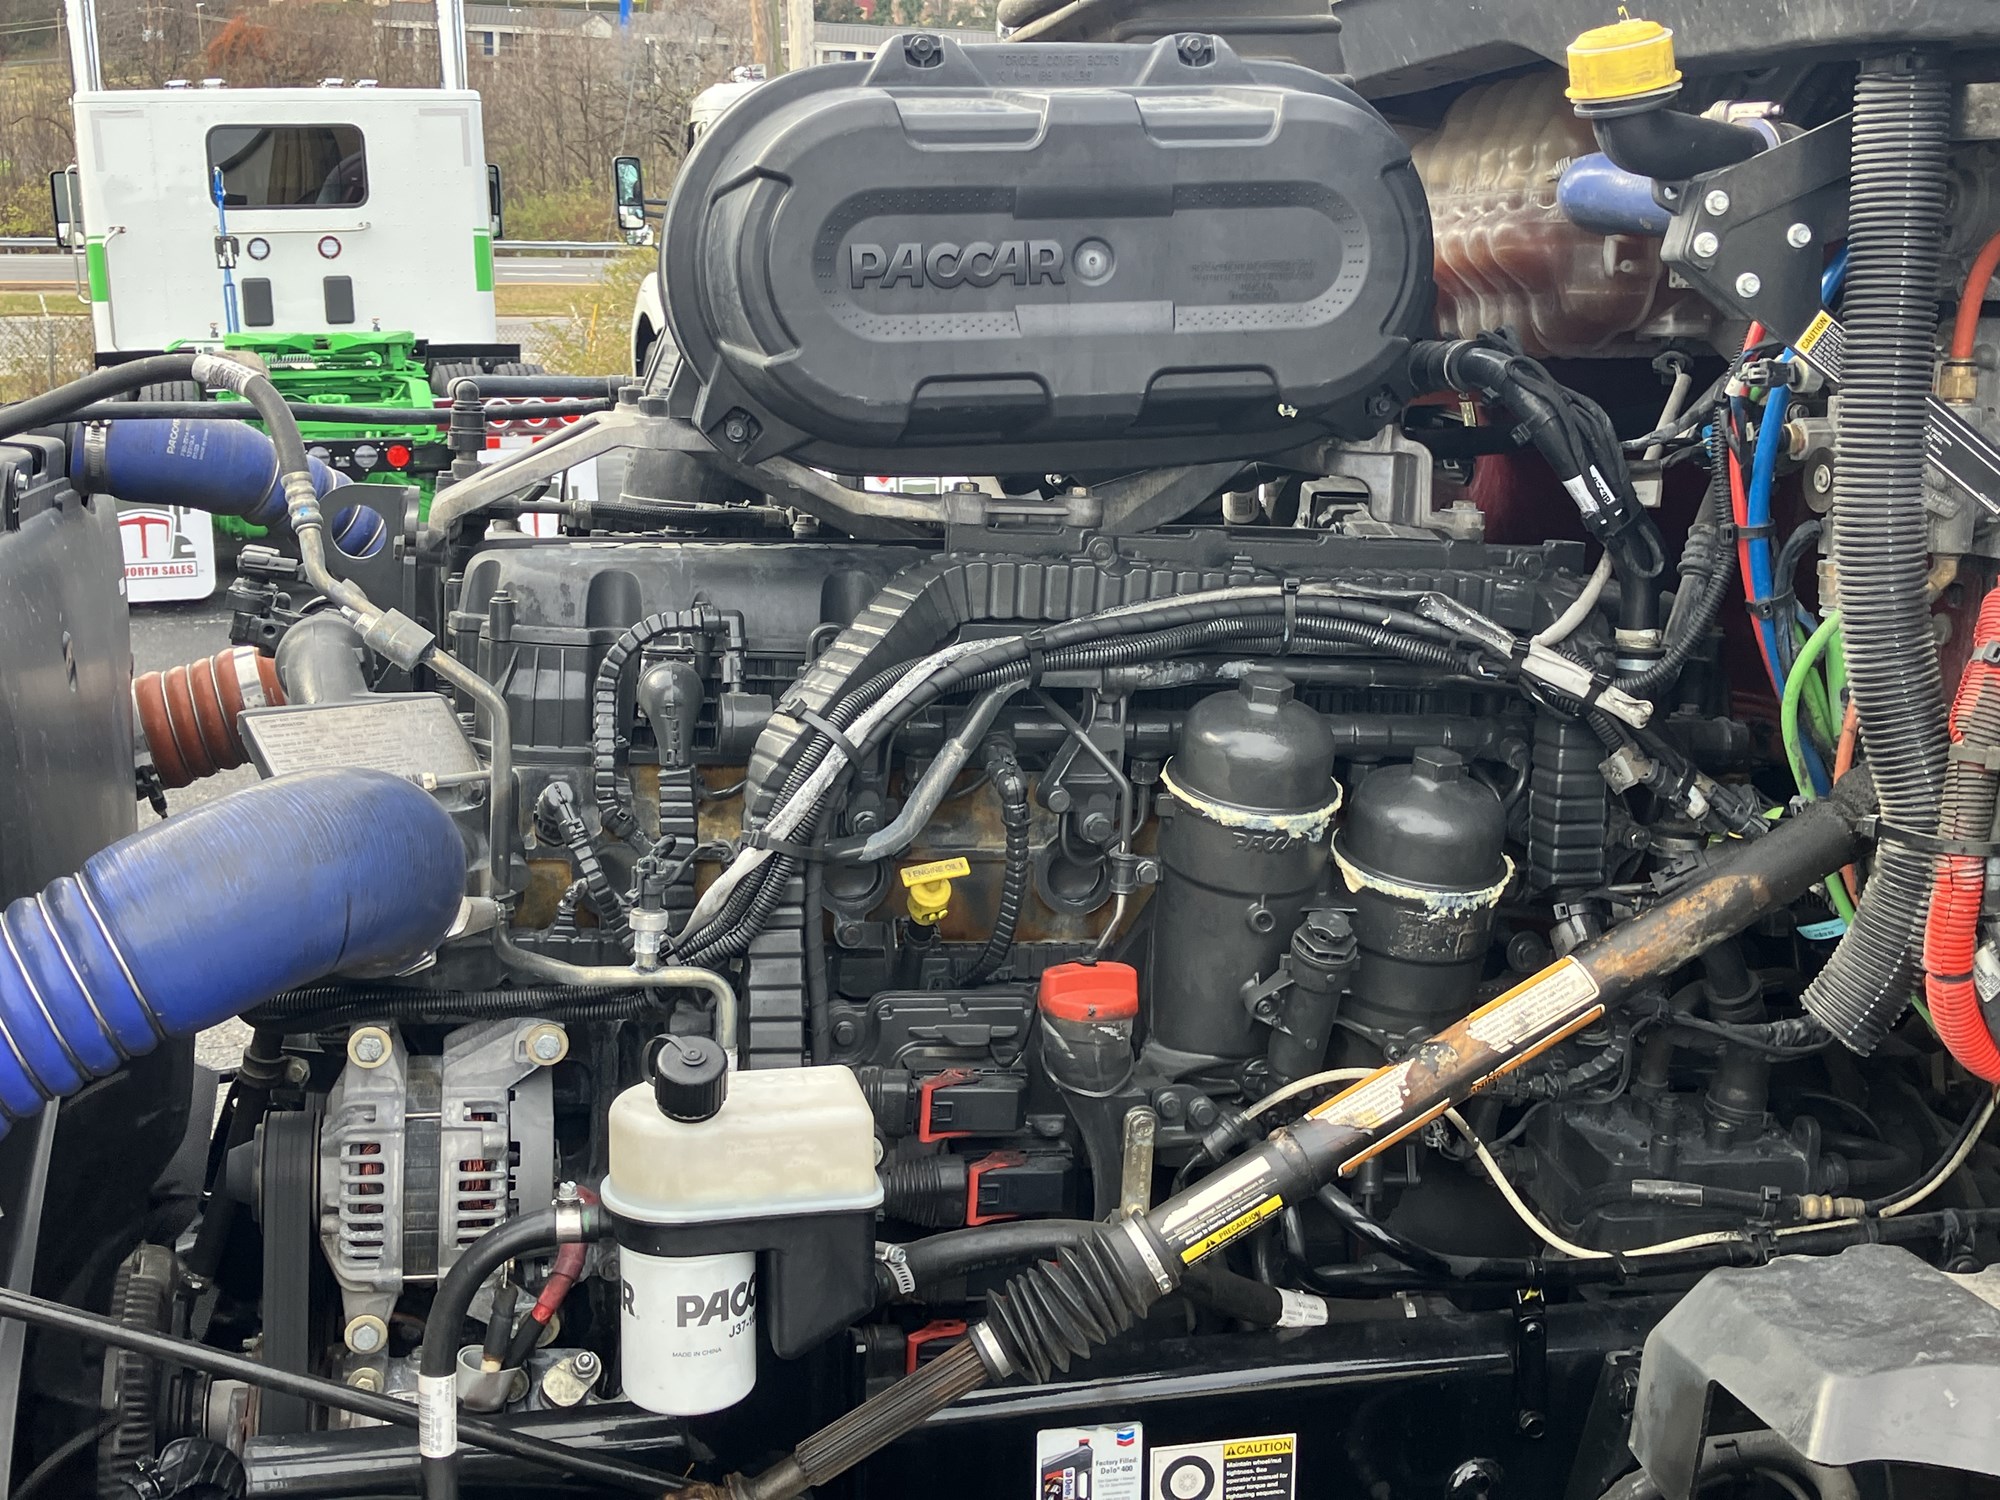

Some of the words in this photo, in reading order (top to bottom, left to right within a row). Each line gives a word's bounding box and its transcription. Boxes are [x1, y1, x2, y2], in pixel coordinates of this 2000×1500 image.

[849, 238, 1066, 290] PACCAR
[1801, 317, 1828, 350] CAUTION
[162, 565, 194, 575] SALES
[912, 864, 943, 877] ENGINE
[944, 862, 956, 870] OIL
[702, 1347, 722, 1356] CHINA
[1236, 1440, 1292, 1455] CAUTION
[1095, 1458, 1118, 1467] Factory
[1226, 1460, 1251, 1468] Maintain
[1225, 1475, 1256, 1484] operator's
[1246, 1482, 1266, 1490] torque
